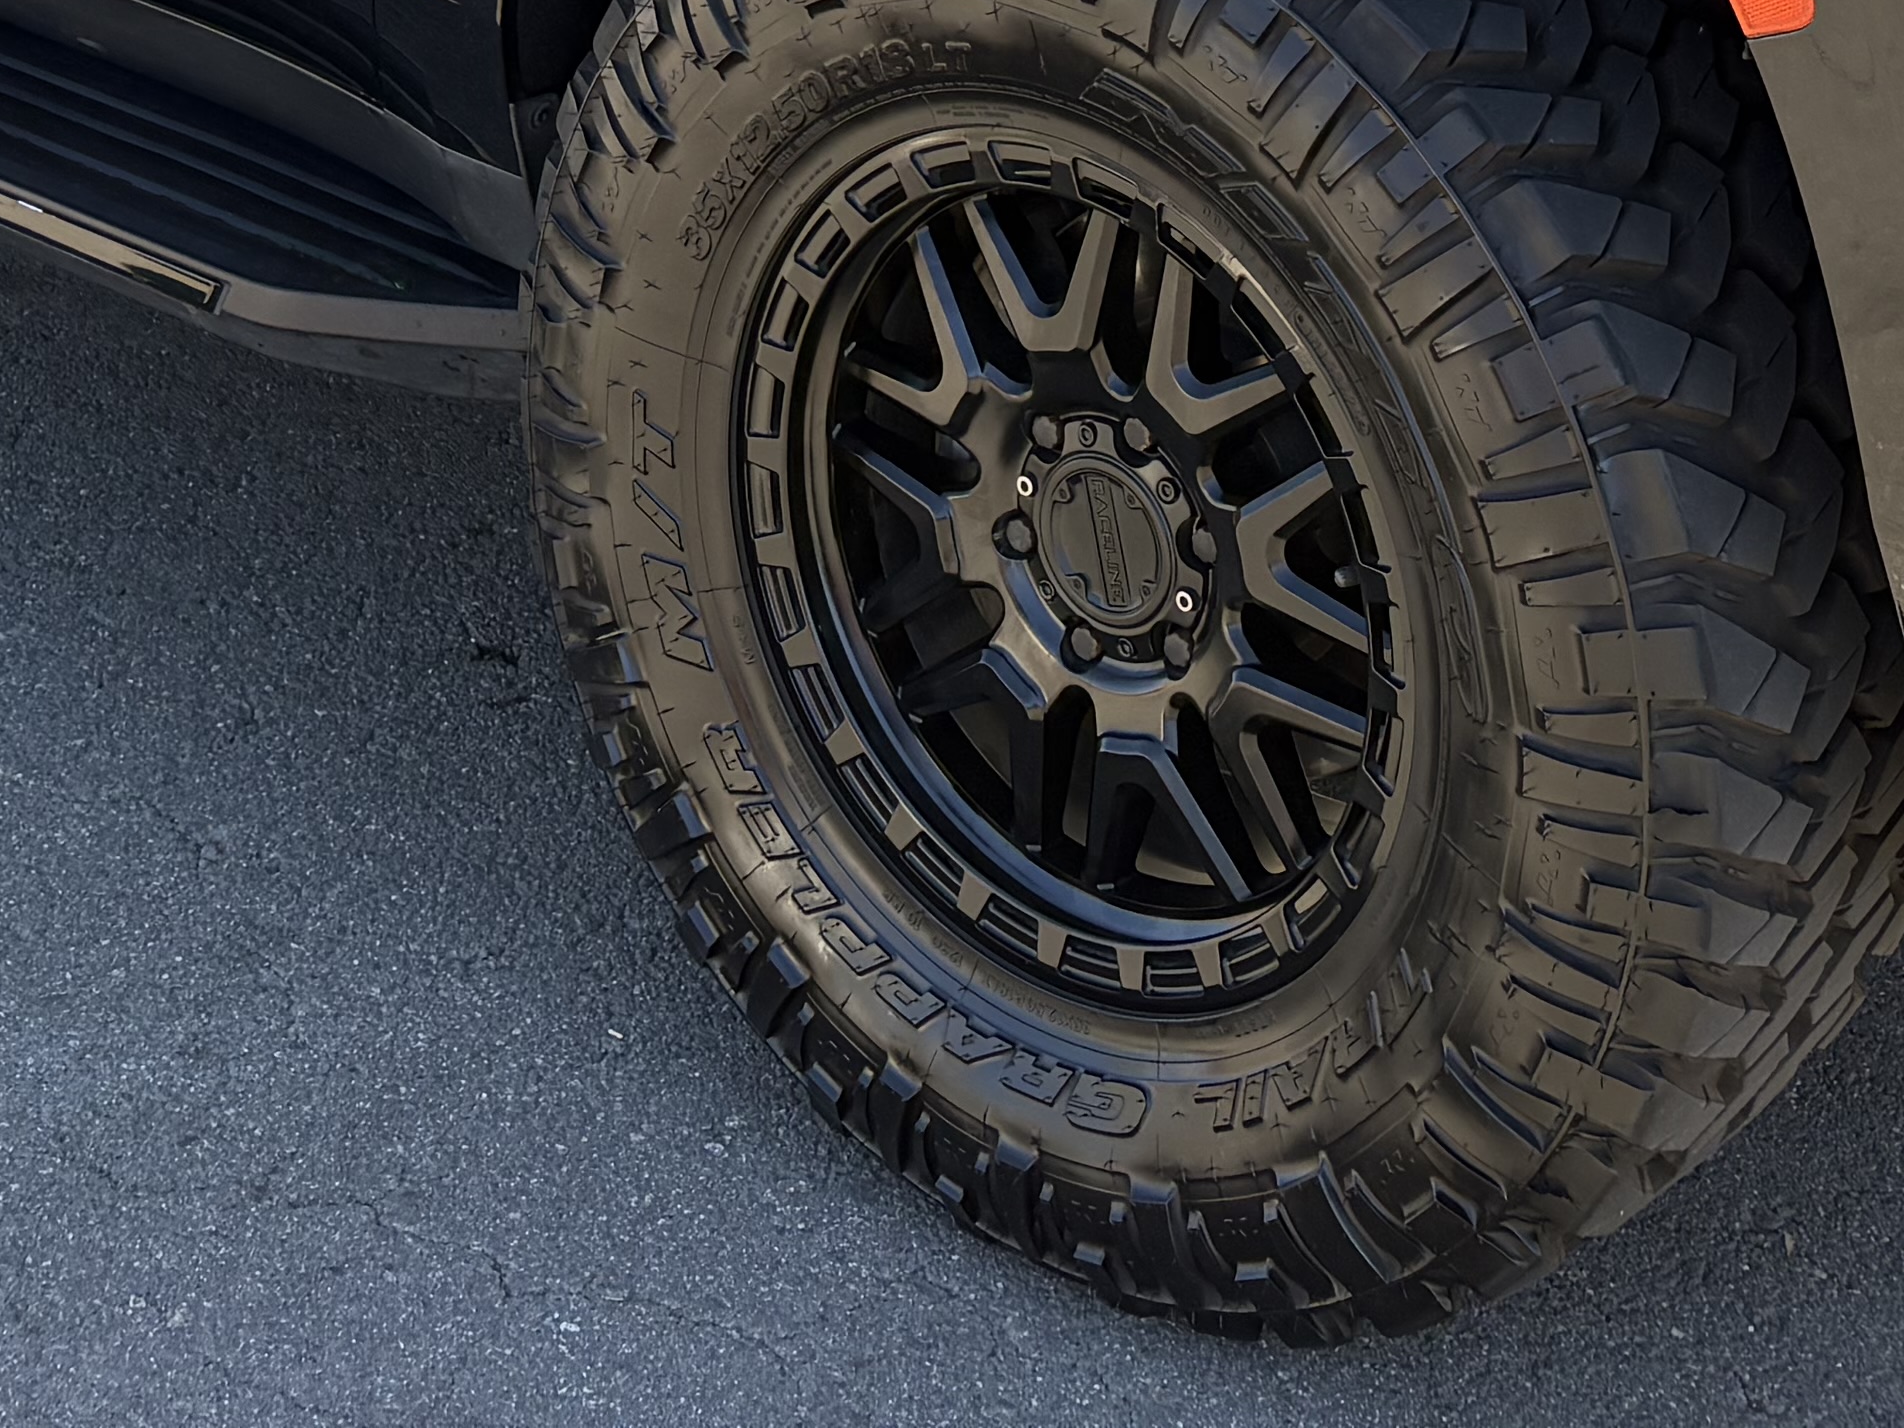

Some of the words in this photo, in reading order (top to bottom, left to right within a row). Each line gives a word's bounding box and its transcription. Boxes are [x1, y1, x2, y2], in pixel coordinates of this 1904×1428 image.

[921, 40, 973, 74] LT
[631, 389, 714, 672] M/T
[1090, 477, 1127, 607] RACELINE
[702, 718, 1152, 1136] GRAPPLER
[1193, 947, 1433, 1133] TRAIL
